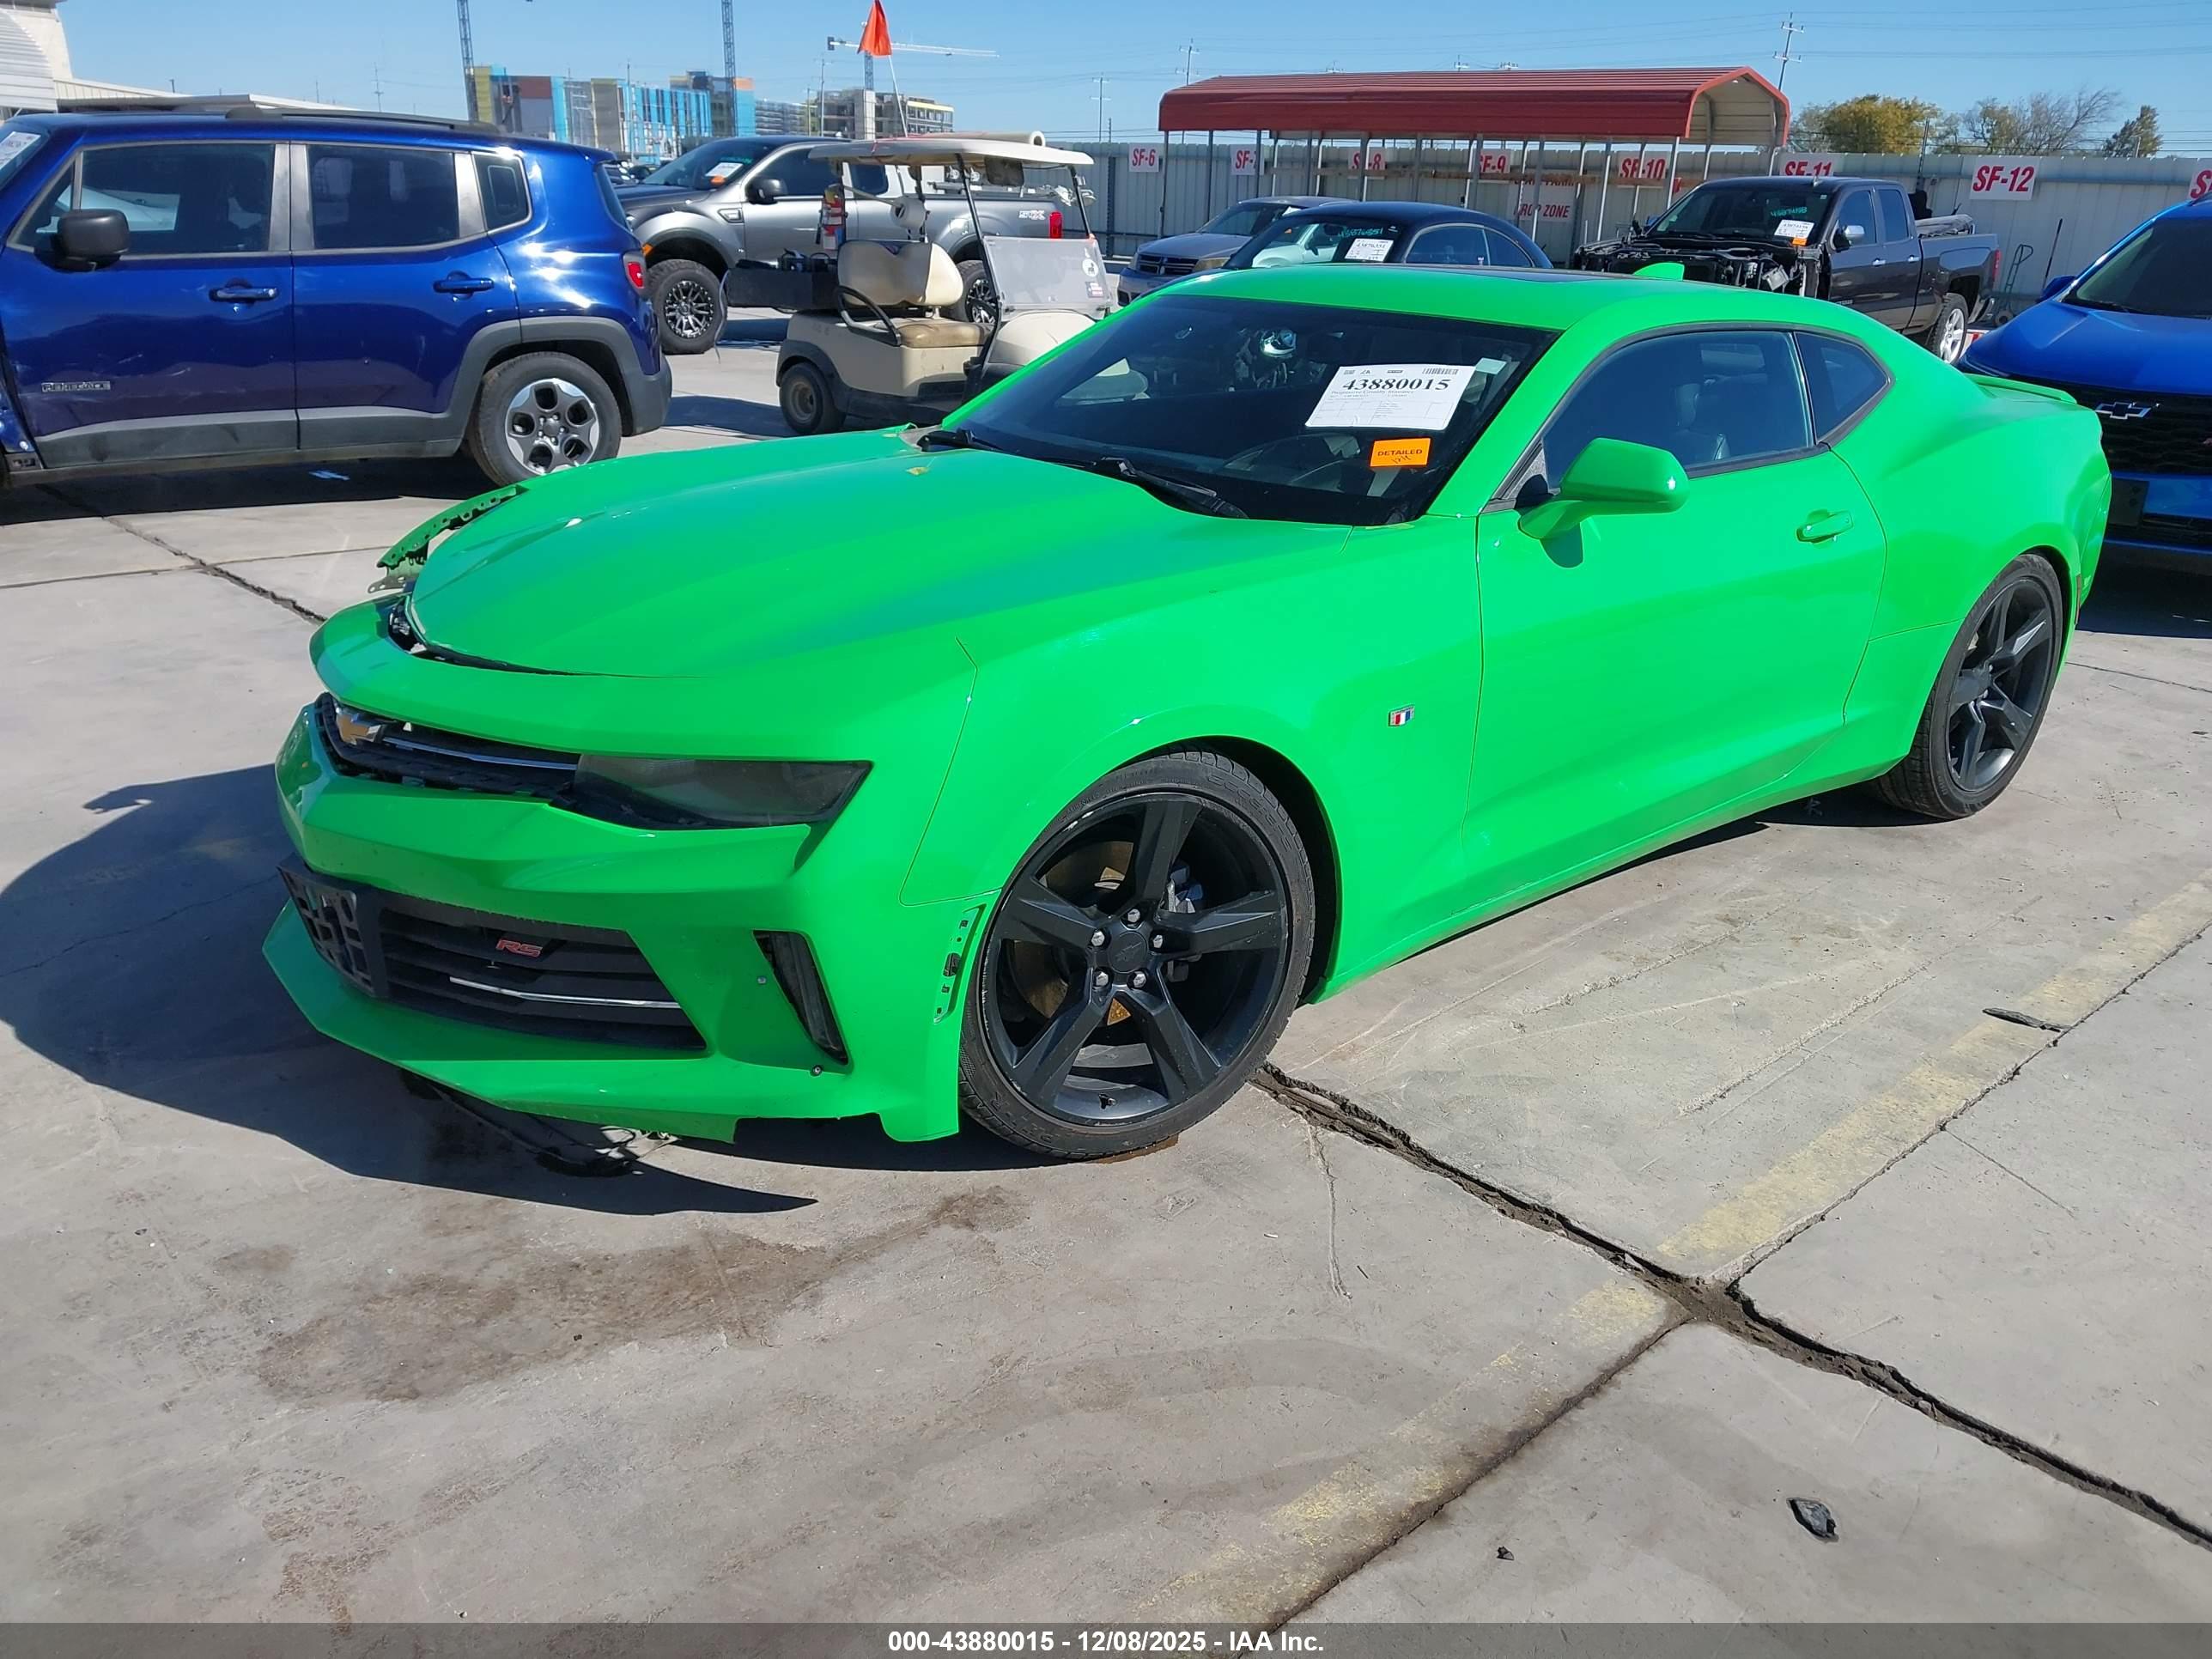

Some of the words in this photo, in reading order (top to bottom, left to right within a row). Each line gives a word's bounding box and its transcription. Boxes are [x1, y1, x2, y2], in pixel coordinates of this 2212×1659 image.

[1132, 148, 1157, 167] SF-6
[1352, 152, 1382, 170] S-8
[1972, 164, 2035, 192] SF-12
[2191, 170, 2212, 198] S
[1543, 204, 1571, 218] ZONE
[1342, 378, 1453, 391] 43880015
[1377, 448, 1423, 457] DETAILED
[495, 939, 544, 958] RS
